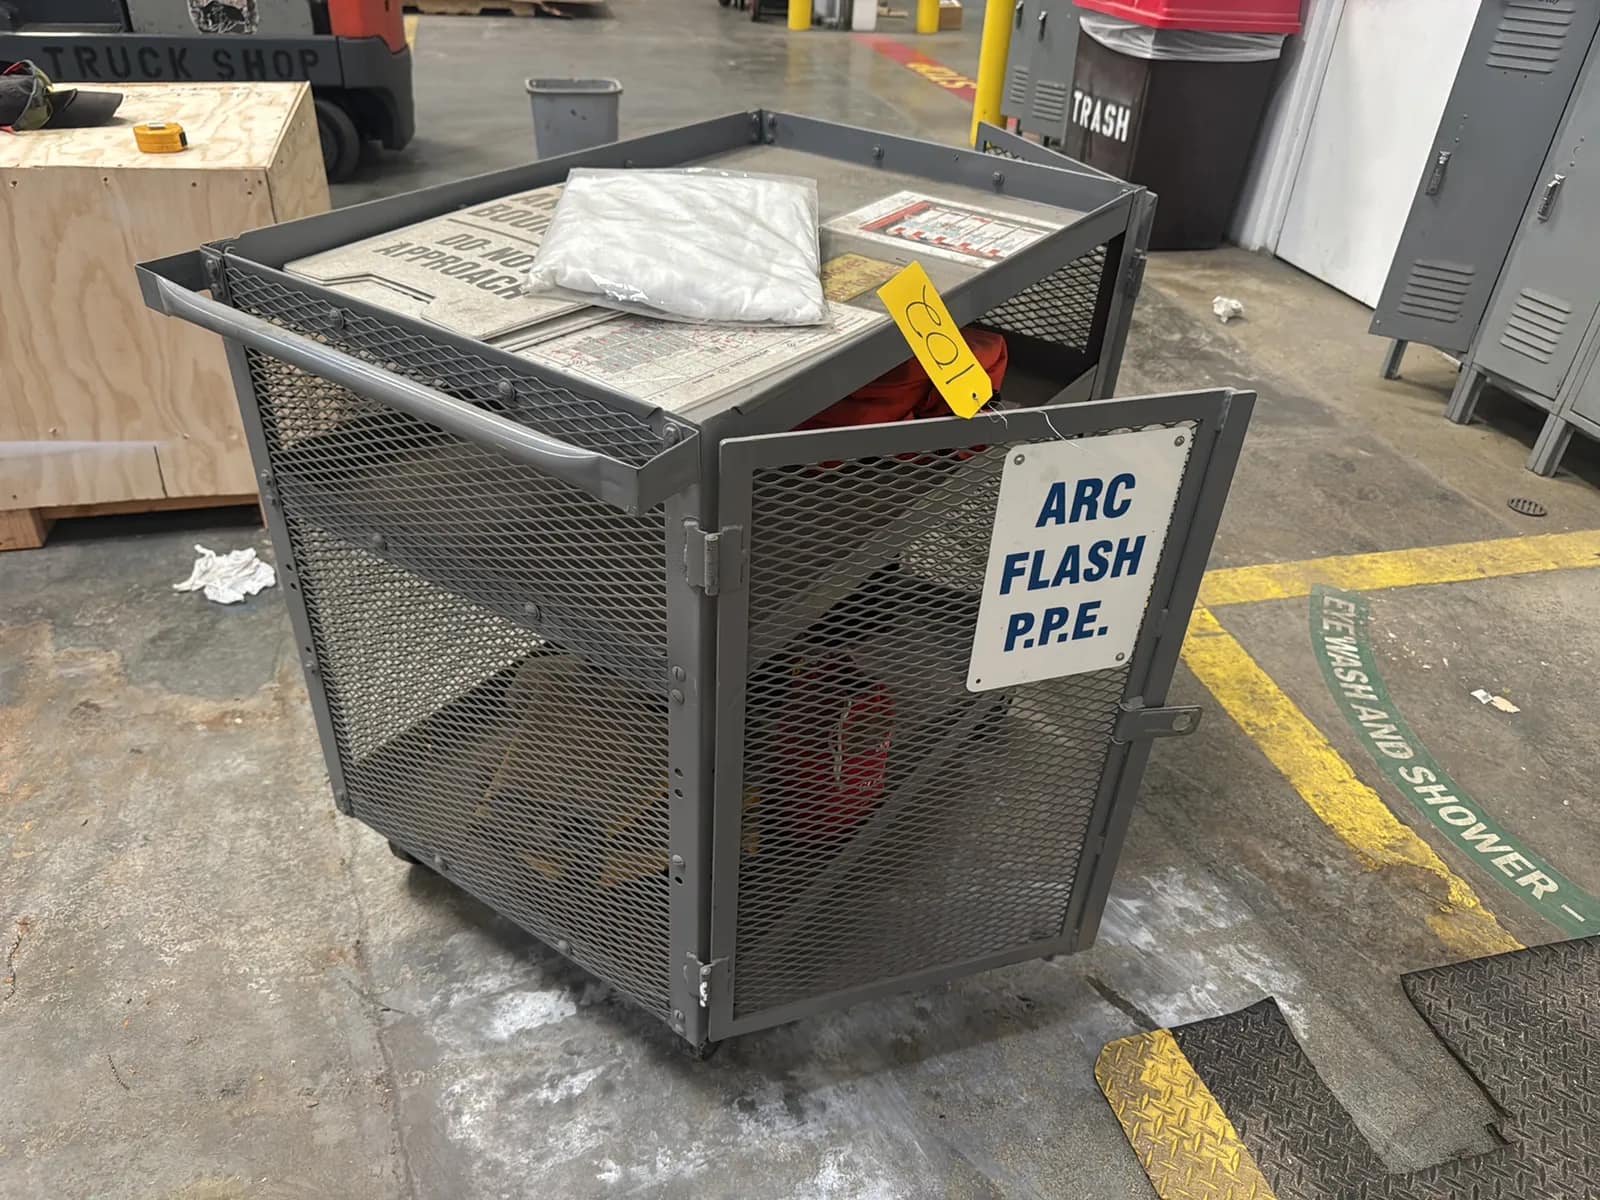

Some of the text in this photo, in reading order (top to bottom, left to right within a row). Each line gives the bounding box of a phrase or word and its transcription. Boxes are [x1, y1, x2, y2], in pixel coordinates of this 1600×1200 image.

[42, 46, 320, 80] TRUCK SHOP
[1072, 90, 1132, 143] TRASH
[436, 233, 534, 273] DO NO
[1035, 472, 1136, 528] ARC
[999, 535, 1147, 596] FLASH
[1003, 600, 1108, 653] P.P.E.
[1351, 703, 1414, 759] AND
[1398, 766, 1559, 900] SHOWER
